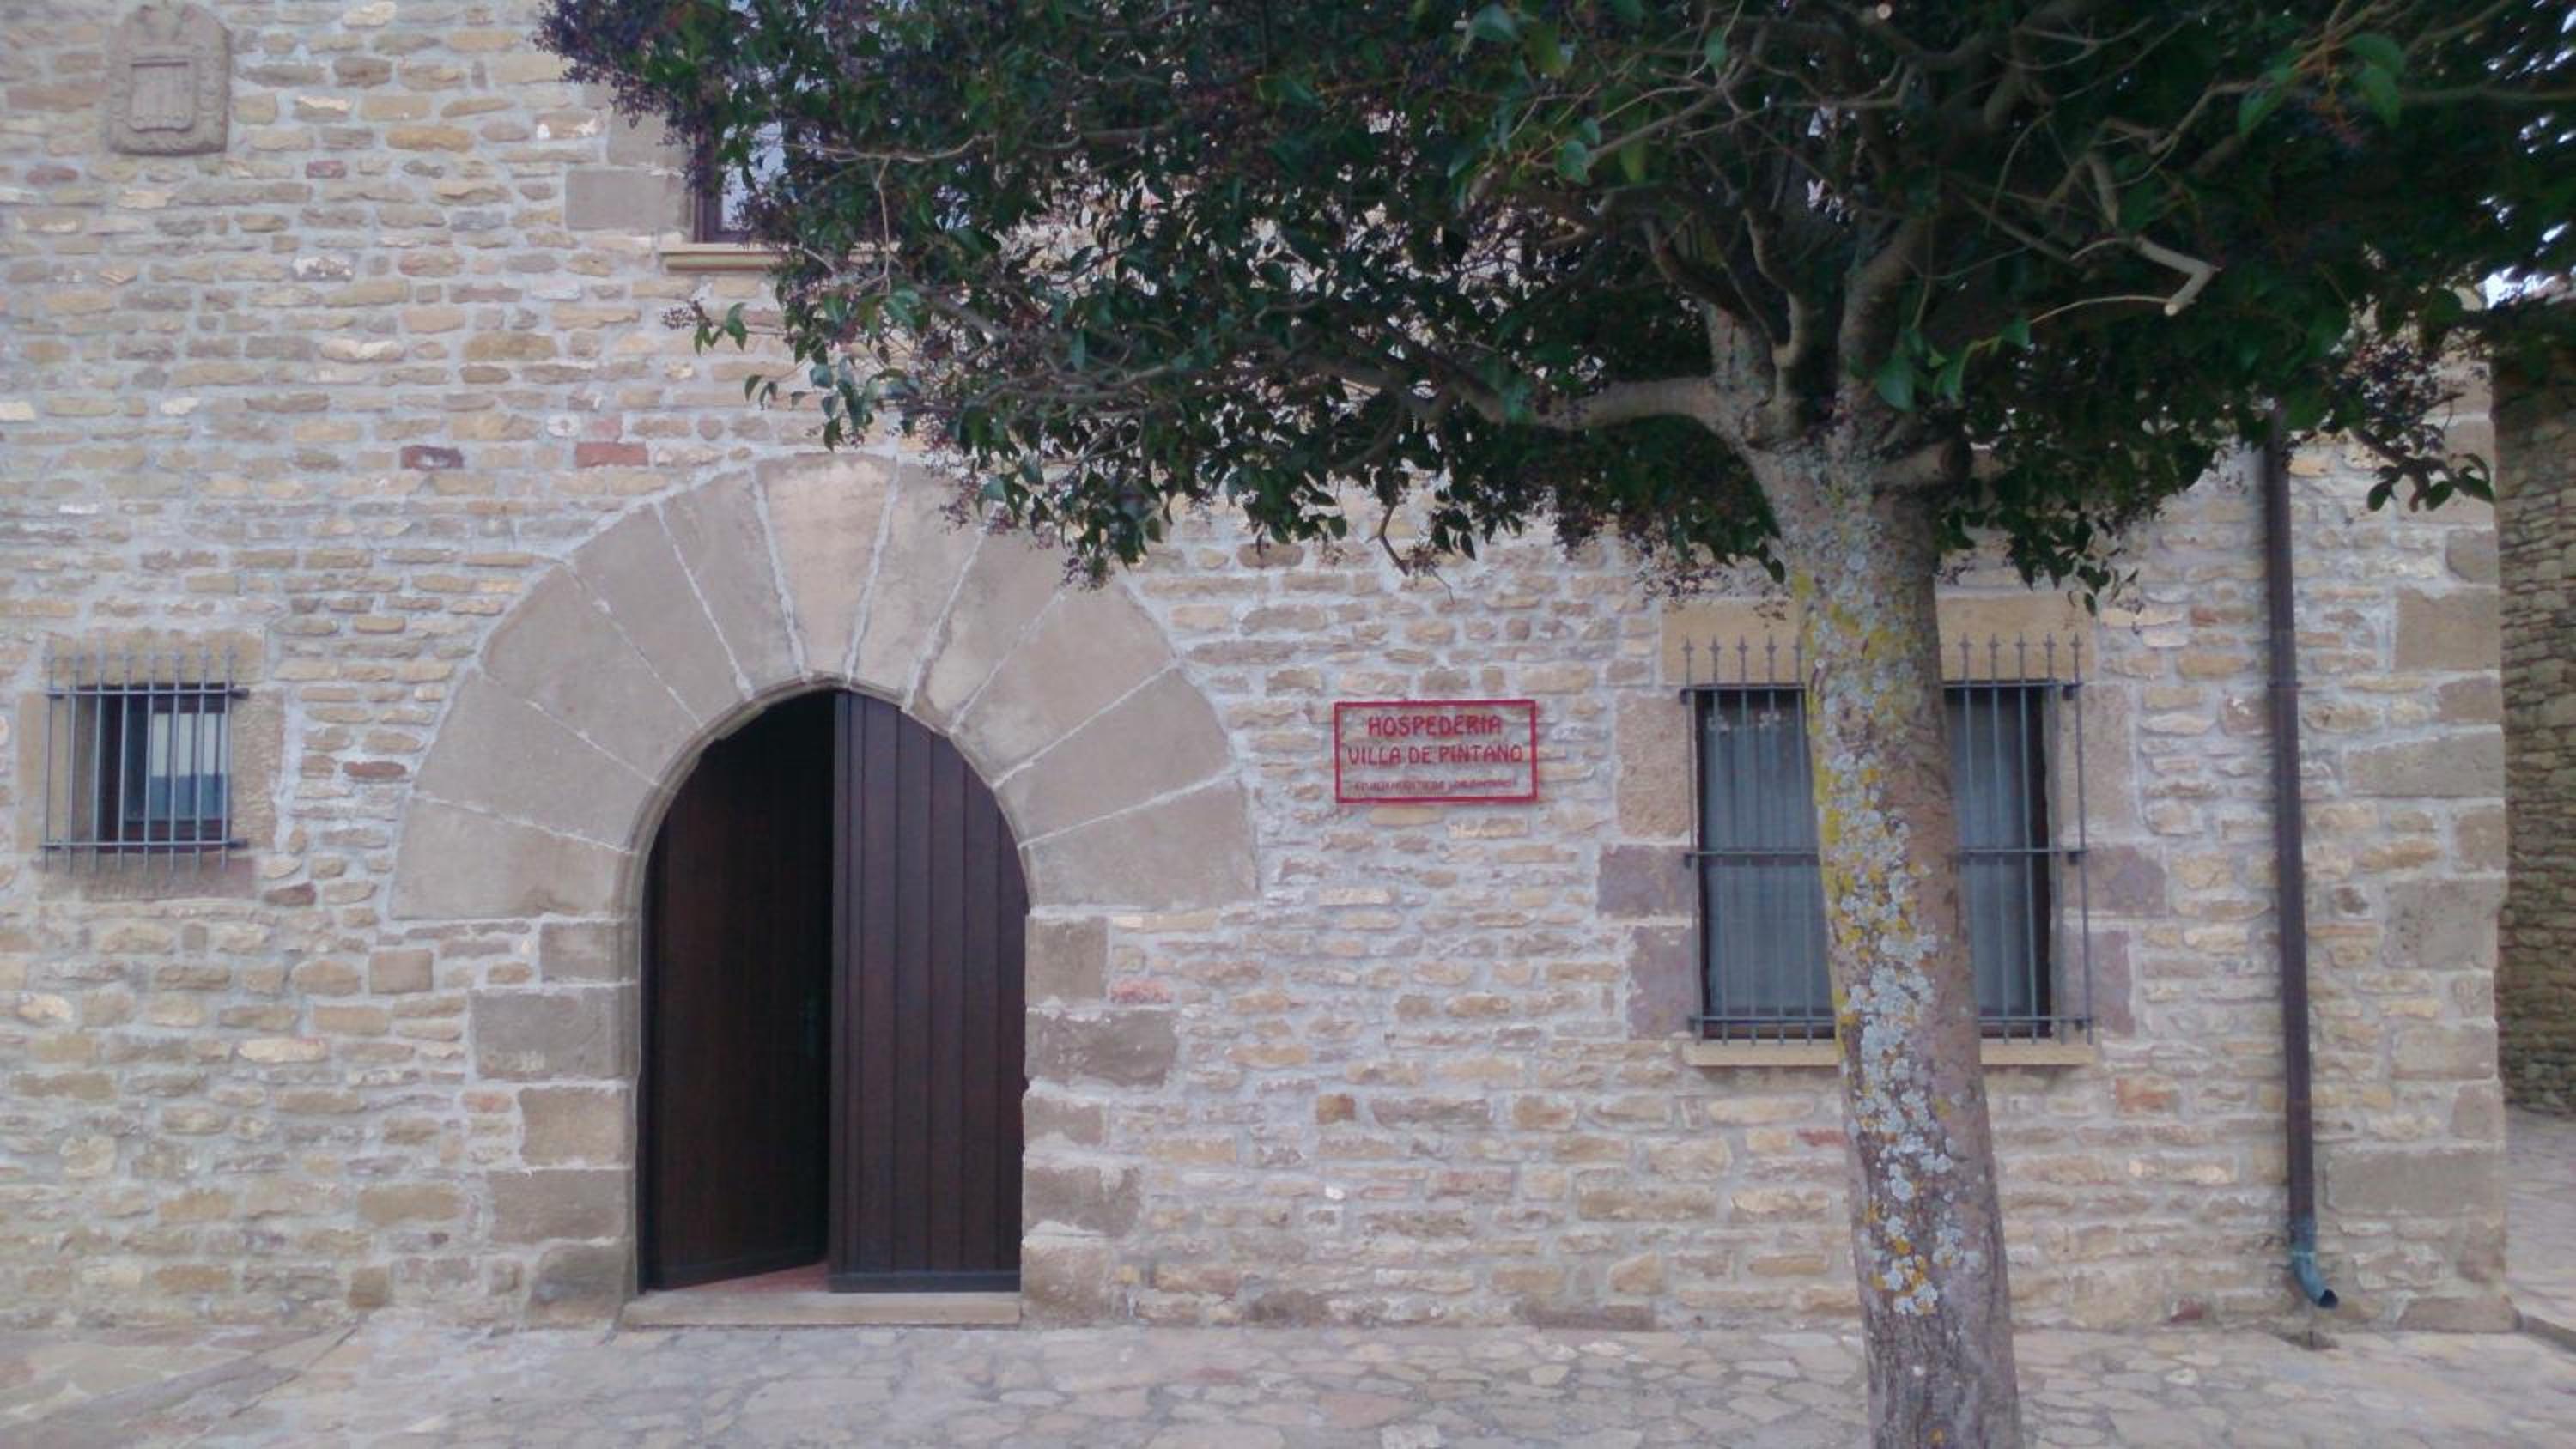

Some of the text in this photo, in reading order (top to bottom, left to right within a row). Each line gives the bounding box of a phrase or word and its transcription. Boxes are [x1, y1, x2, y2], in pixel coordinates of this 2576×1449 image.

[1348, 744, 1523, 765] VILLA DE PINTANO
